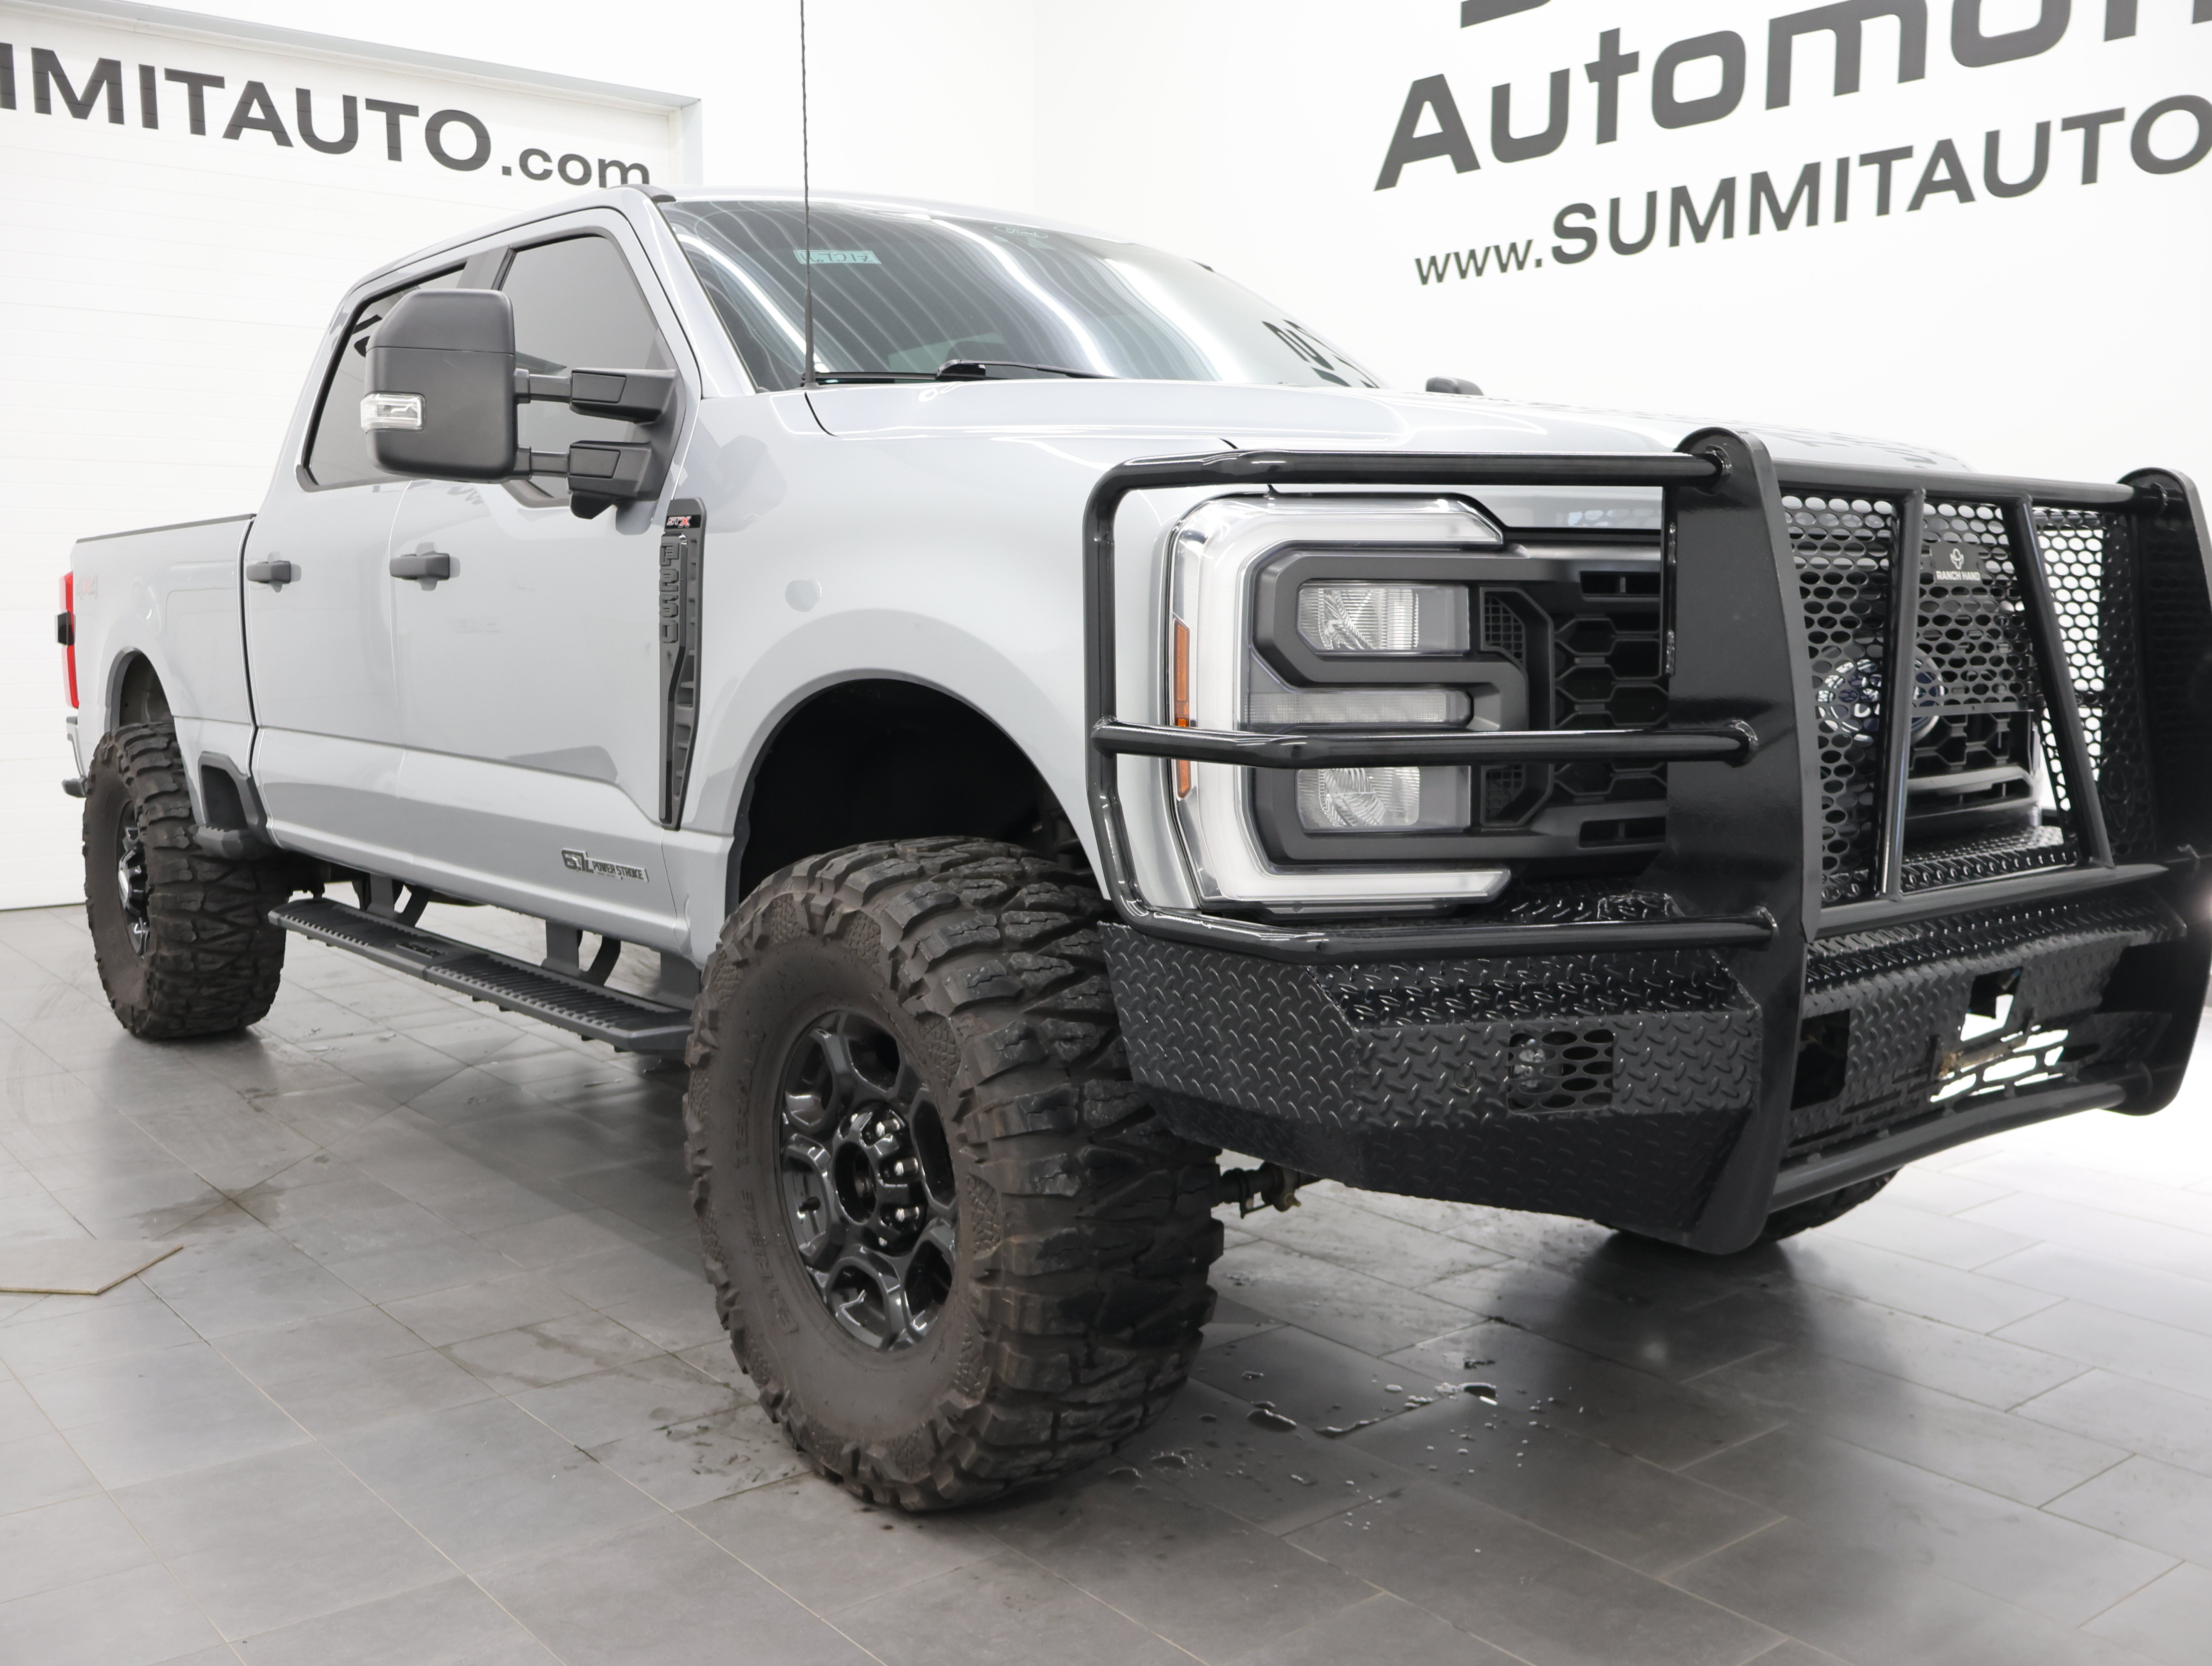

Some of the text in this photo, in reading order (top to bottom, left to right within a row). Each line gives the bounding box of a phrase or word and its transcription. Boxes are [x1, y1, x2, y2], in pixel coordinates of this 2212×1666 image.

[0, 41, 650, 189] MITAUTO.com
[666, 516, 692, 528] STX
[1935, 570, 1981, 581] RANCH HAND
[592, 860, 616, 875] POWER
[616, 865, 644, 880] STROKE
